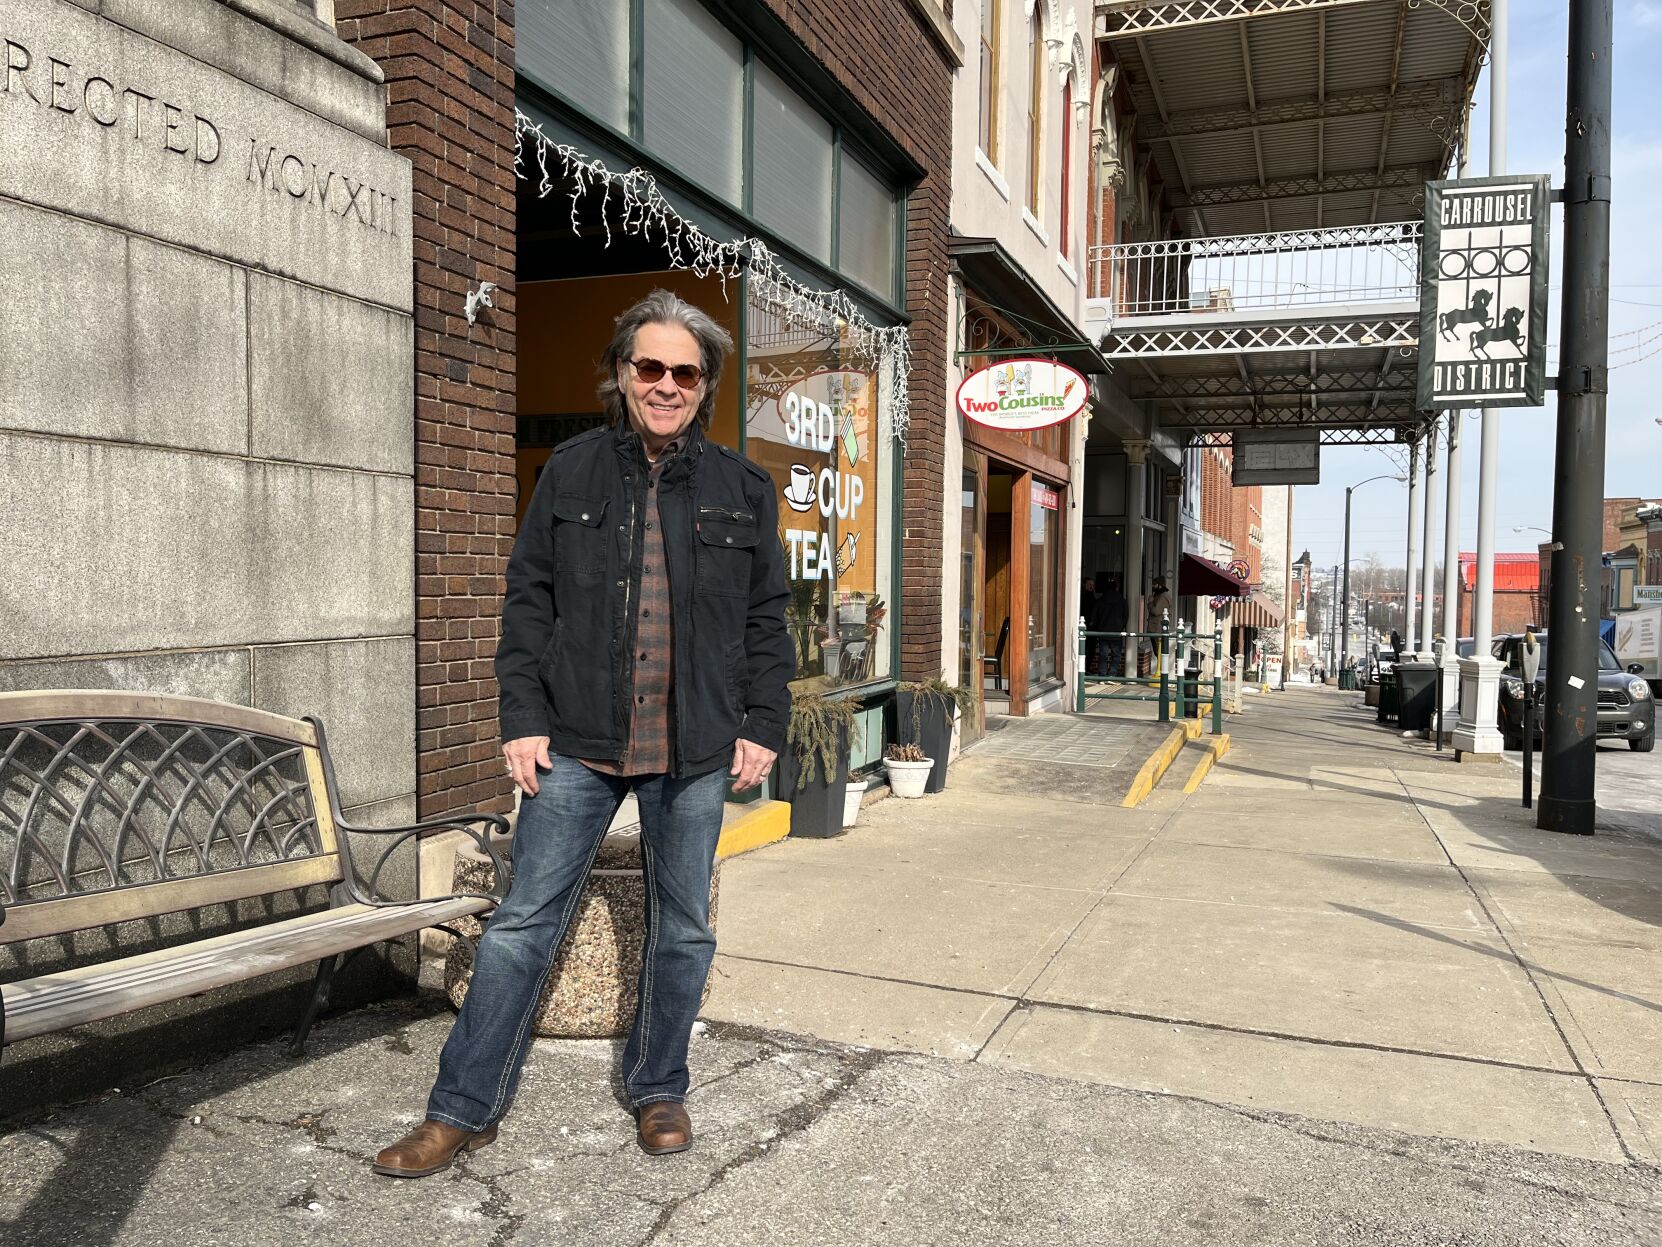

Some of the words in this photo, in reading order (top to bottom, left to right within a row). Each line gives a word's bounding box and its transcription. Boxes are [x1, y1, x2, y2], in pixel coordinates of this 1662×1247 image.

[246, 138, 397, 236] MCMXIII
[1440, 193, 1533, 226] CARROUSEL
[963, 397, 998, 412] Two
[998, 393, 1064, 411] Cousins
[1433, 361, 1528, 392] DISTRICT
[785, 391, 835, 453] 3RD
[818, 467, 864, 520] CUP
[785, 528, 834, 580] TEA
